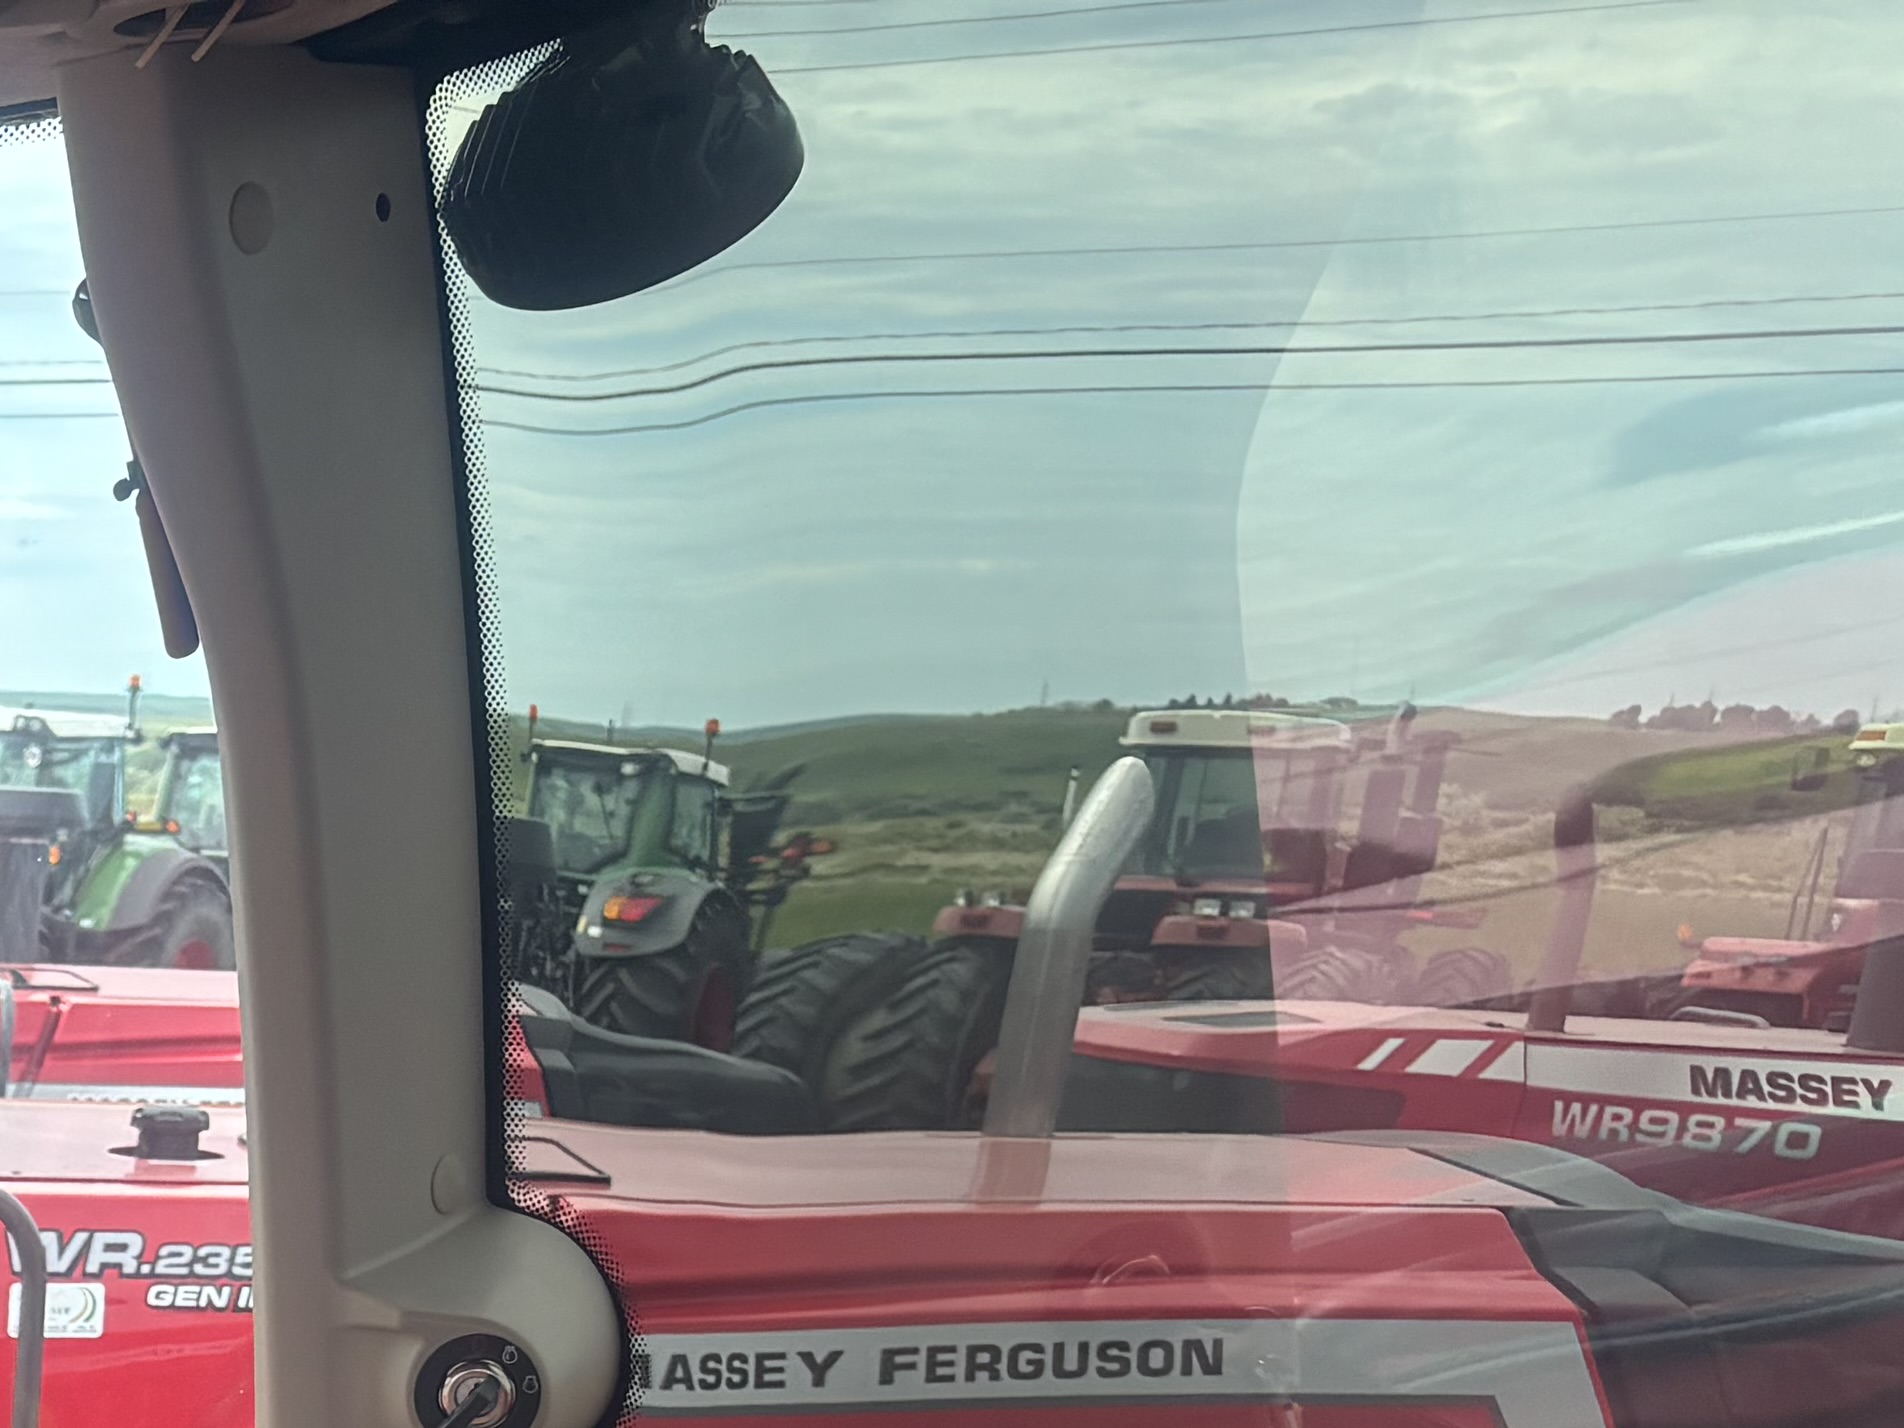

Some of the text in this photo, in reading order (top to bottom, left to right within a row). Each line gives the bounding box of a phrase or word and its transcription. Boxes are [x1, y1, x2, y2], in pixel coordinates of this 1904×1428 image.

[1689, 1064, 1893, 1111] MASSEY
[1551, 1100, 1822, 1161] WR9870
[146, 1283, 231, 1309] GEN
[878, 1337, 1225, 1387] FERGUSON
